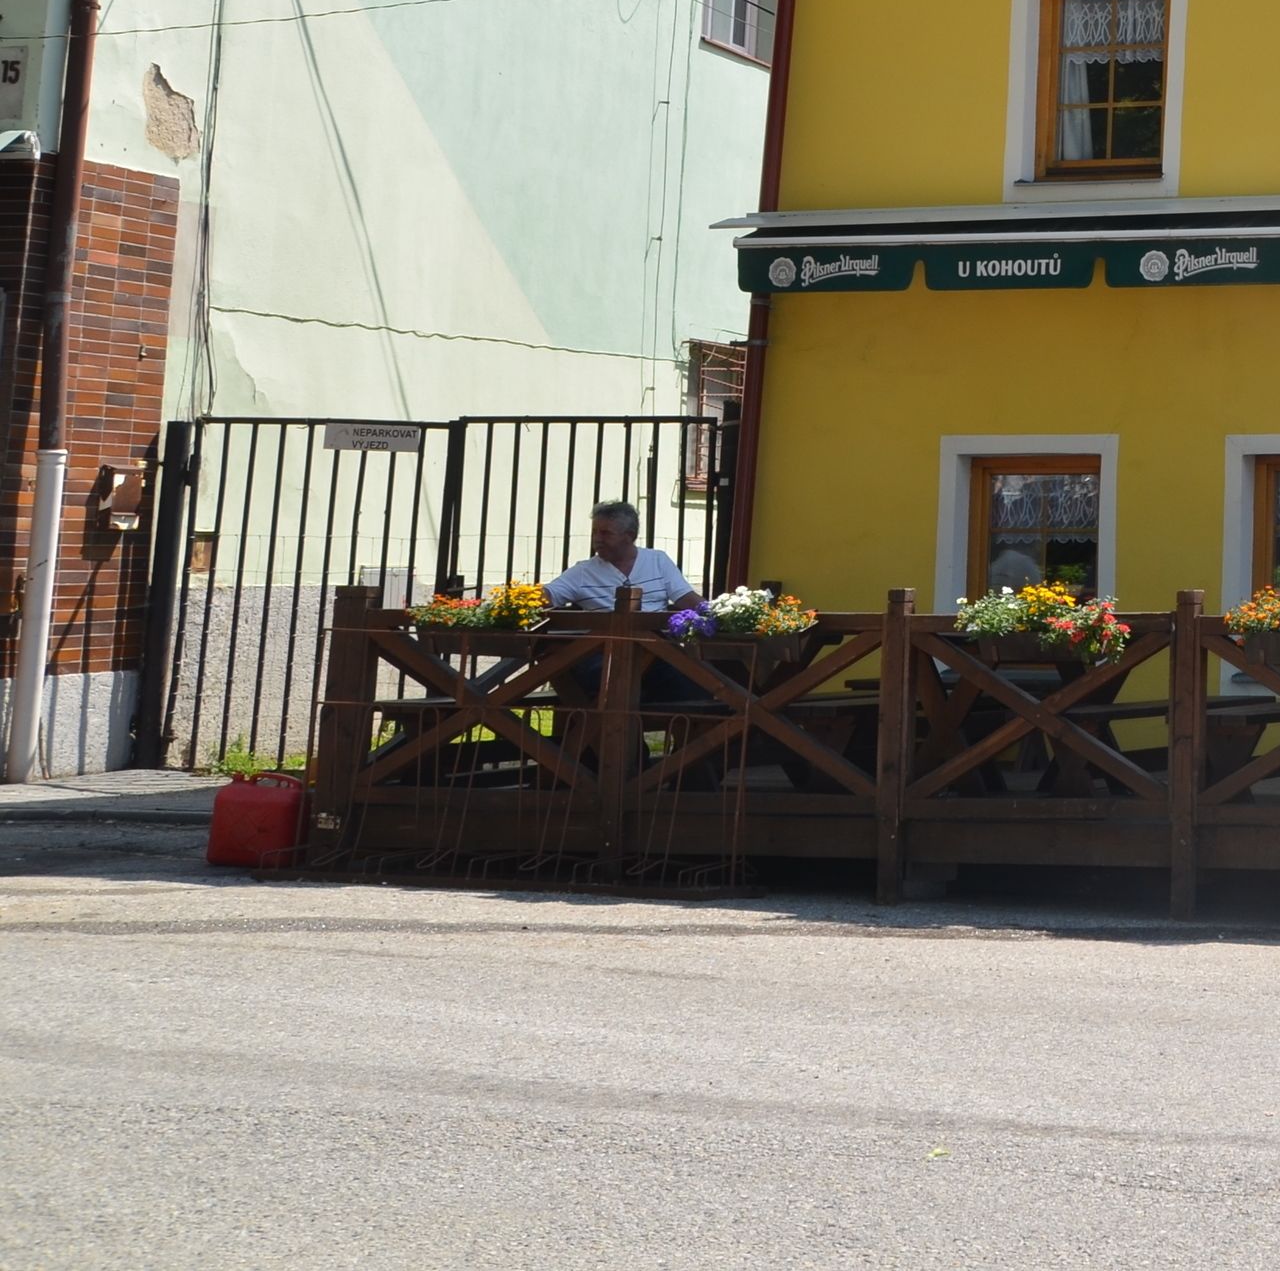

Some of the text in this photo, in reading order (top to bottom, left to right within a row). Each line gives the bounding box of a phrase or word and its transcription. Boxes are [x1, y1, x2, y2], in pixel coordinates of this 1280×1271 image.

[1, 59, 21, 84] 15
[801, 254, 879, 287] Pilsner Urquell
[958, 252, 1061, 277] U KOHOUTŮ
[1174, 246, 1257, 281] Pilsner Urquell
[352, 427, 418, 439] NEPARKOVAT
